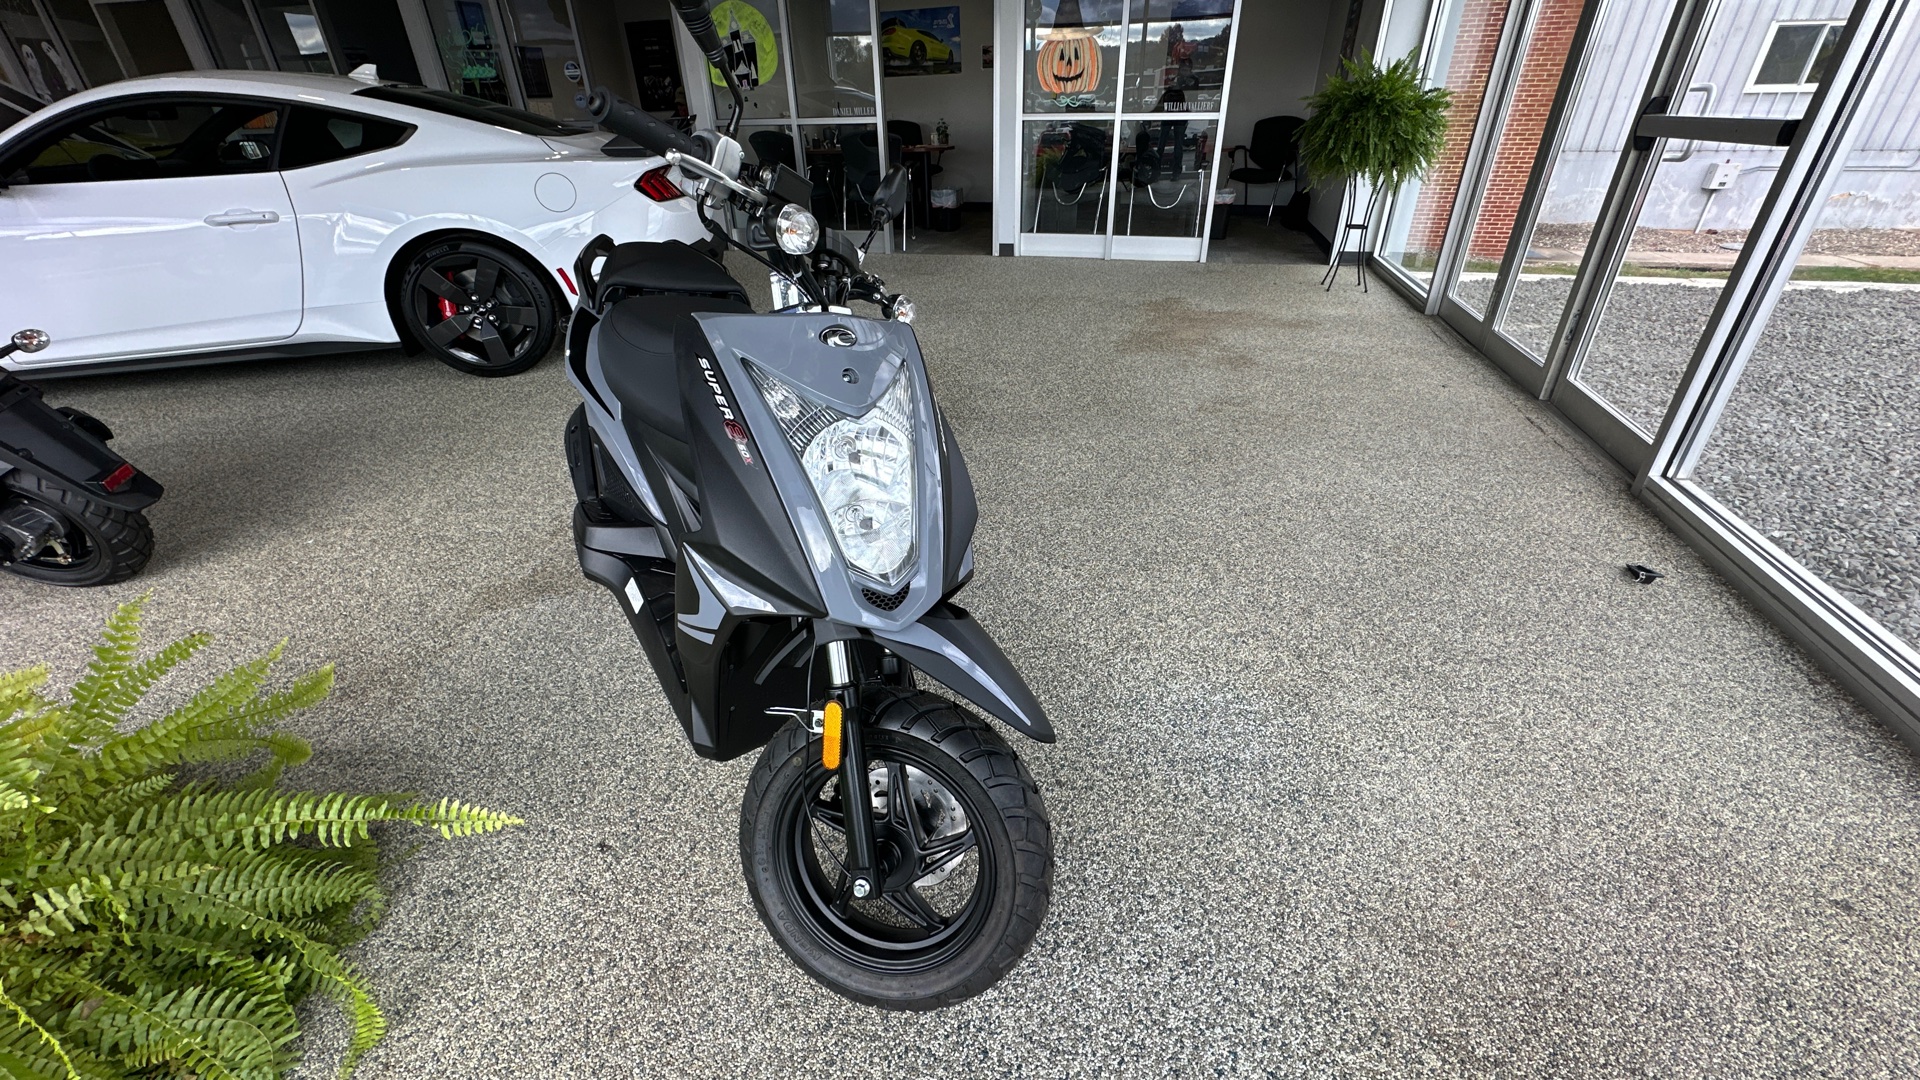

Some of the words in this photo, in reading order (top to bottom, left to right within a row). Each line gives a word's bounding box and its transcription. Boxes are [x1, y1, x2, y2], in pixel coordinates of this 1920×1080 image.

[832, 107, 853, 117] DANIEL
[853, 106, 875, 116] MILLER
[698, 357, 735, 421] SUPER
[777, 910, 823, 962] KENDA
